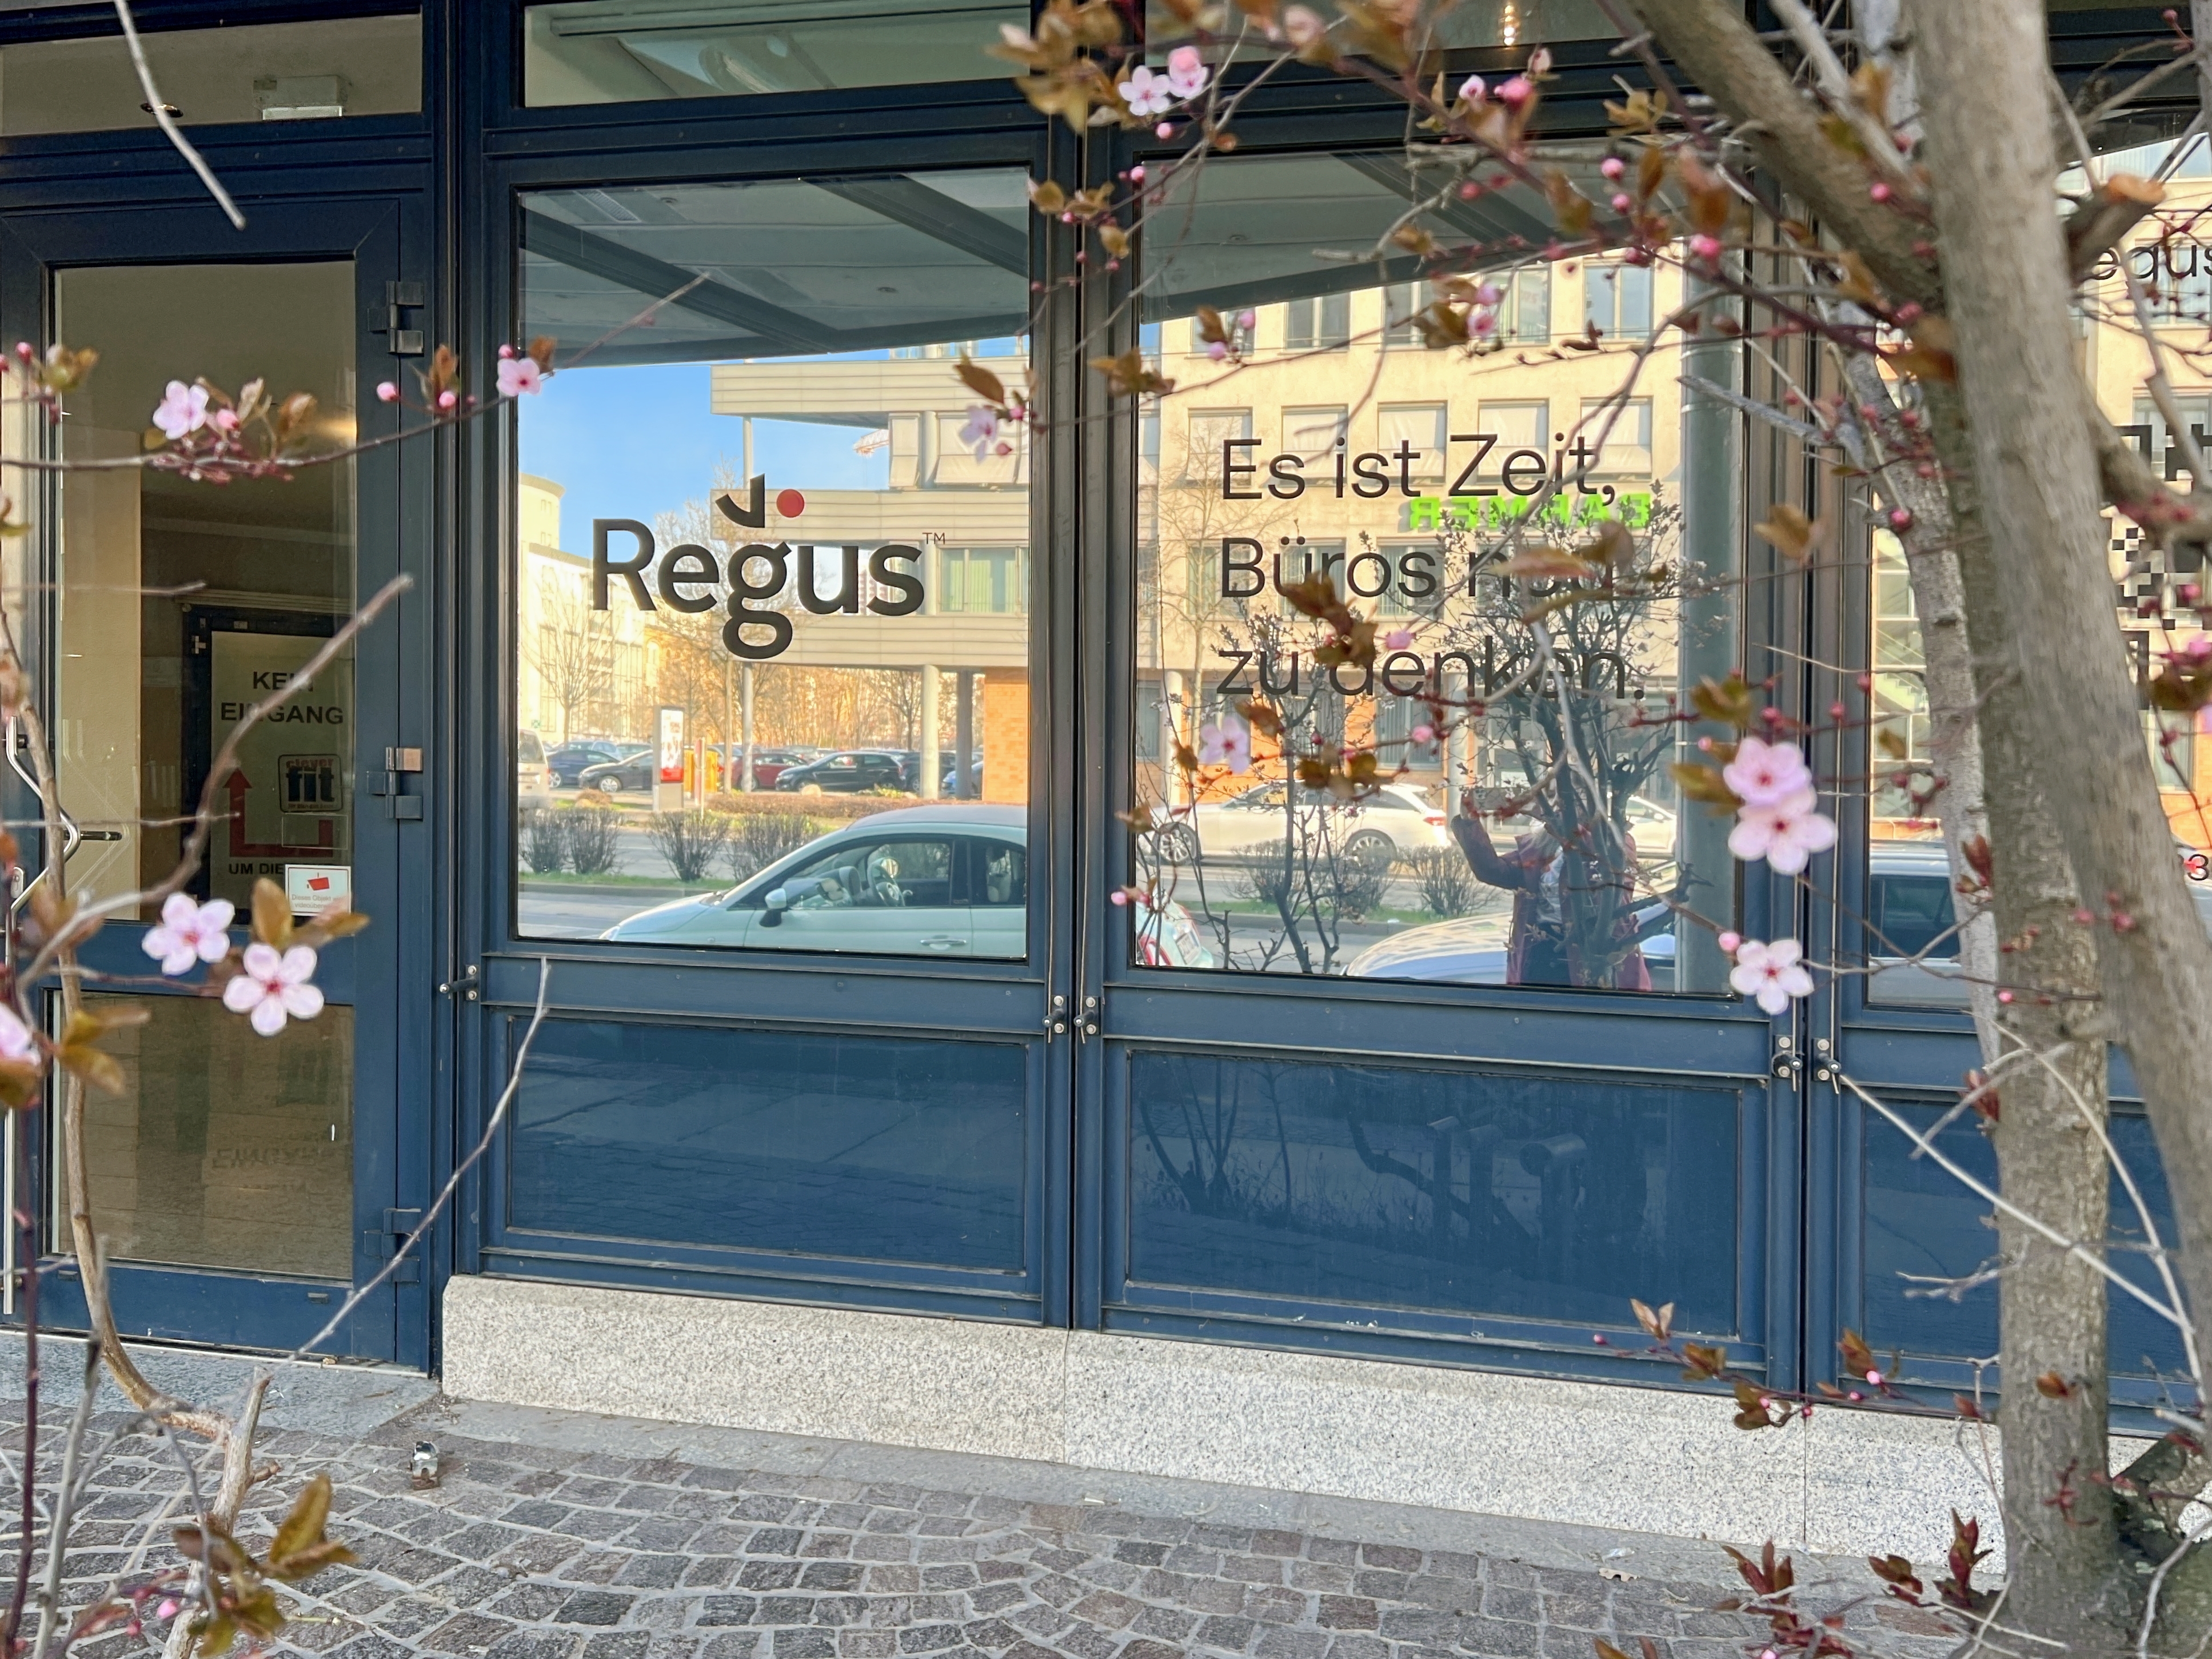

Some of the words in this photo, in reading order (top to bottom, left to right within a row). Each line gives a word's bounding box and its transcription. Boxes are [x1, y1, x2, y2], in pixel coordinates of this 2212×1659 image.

[1223, 438, 1306, 500] Es
[1335, 436, 1421, 498] ist
[1448, 432, 1616, 507] Zeit,
[1221, 536, 1437, 598] Büros
[592, 517, 925, 659] Regus
[1216, 651, 1299, 696] zu
[221, 702, 344, 724] EIGANG
[285, 765, 335, 802] fit
[229, 863, 253, 875] UM
[259, 863, 285, 875] DIE
[312, 895, 332, 903] Objekt
